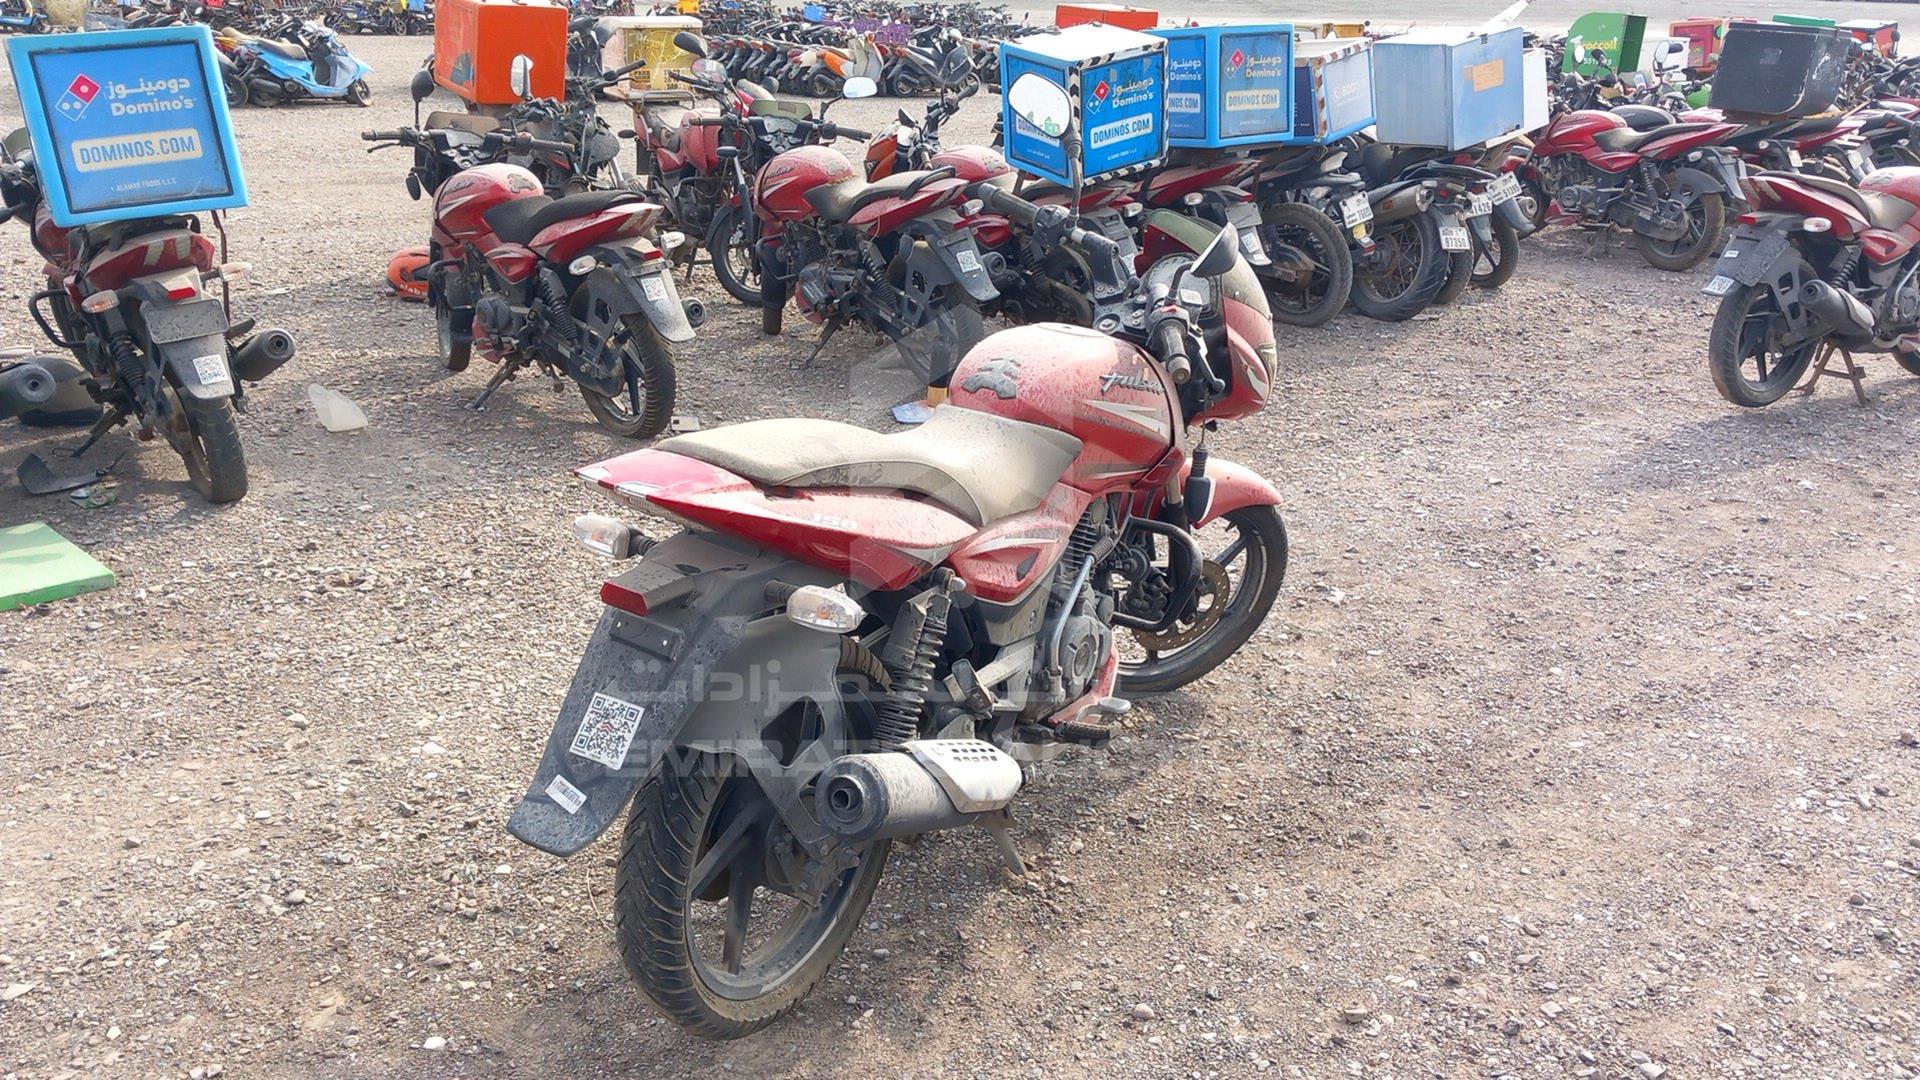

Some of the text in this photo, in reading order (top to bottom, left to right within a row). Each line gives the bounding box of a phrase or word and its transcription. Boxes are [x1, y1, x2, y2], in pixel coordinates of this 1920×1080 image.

[110, 95, 195, 117] Domino's
[1112, 91, 1154, 109] Domino's
[79, 136, 196, 165] DOMINOS.COM
